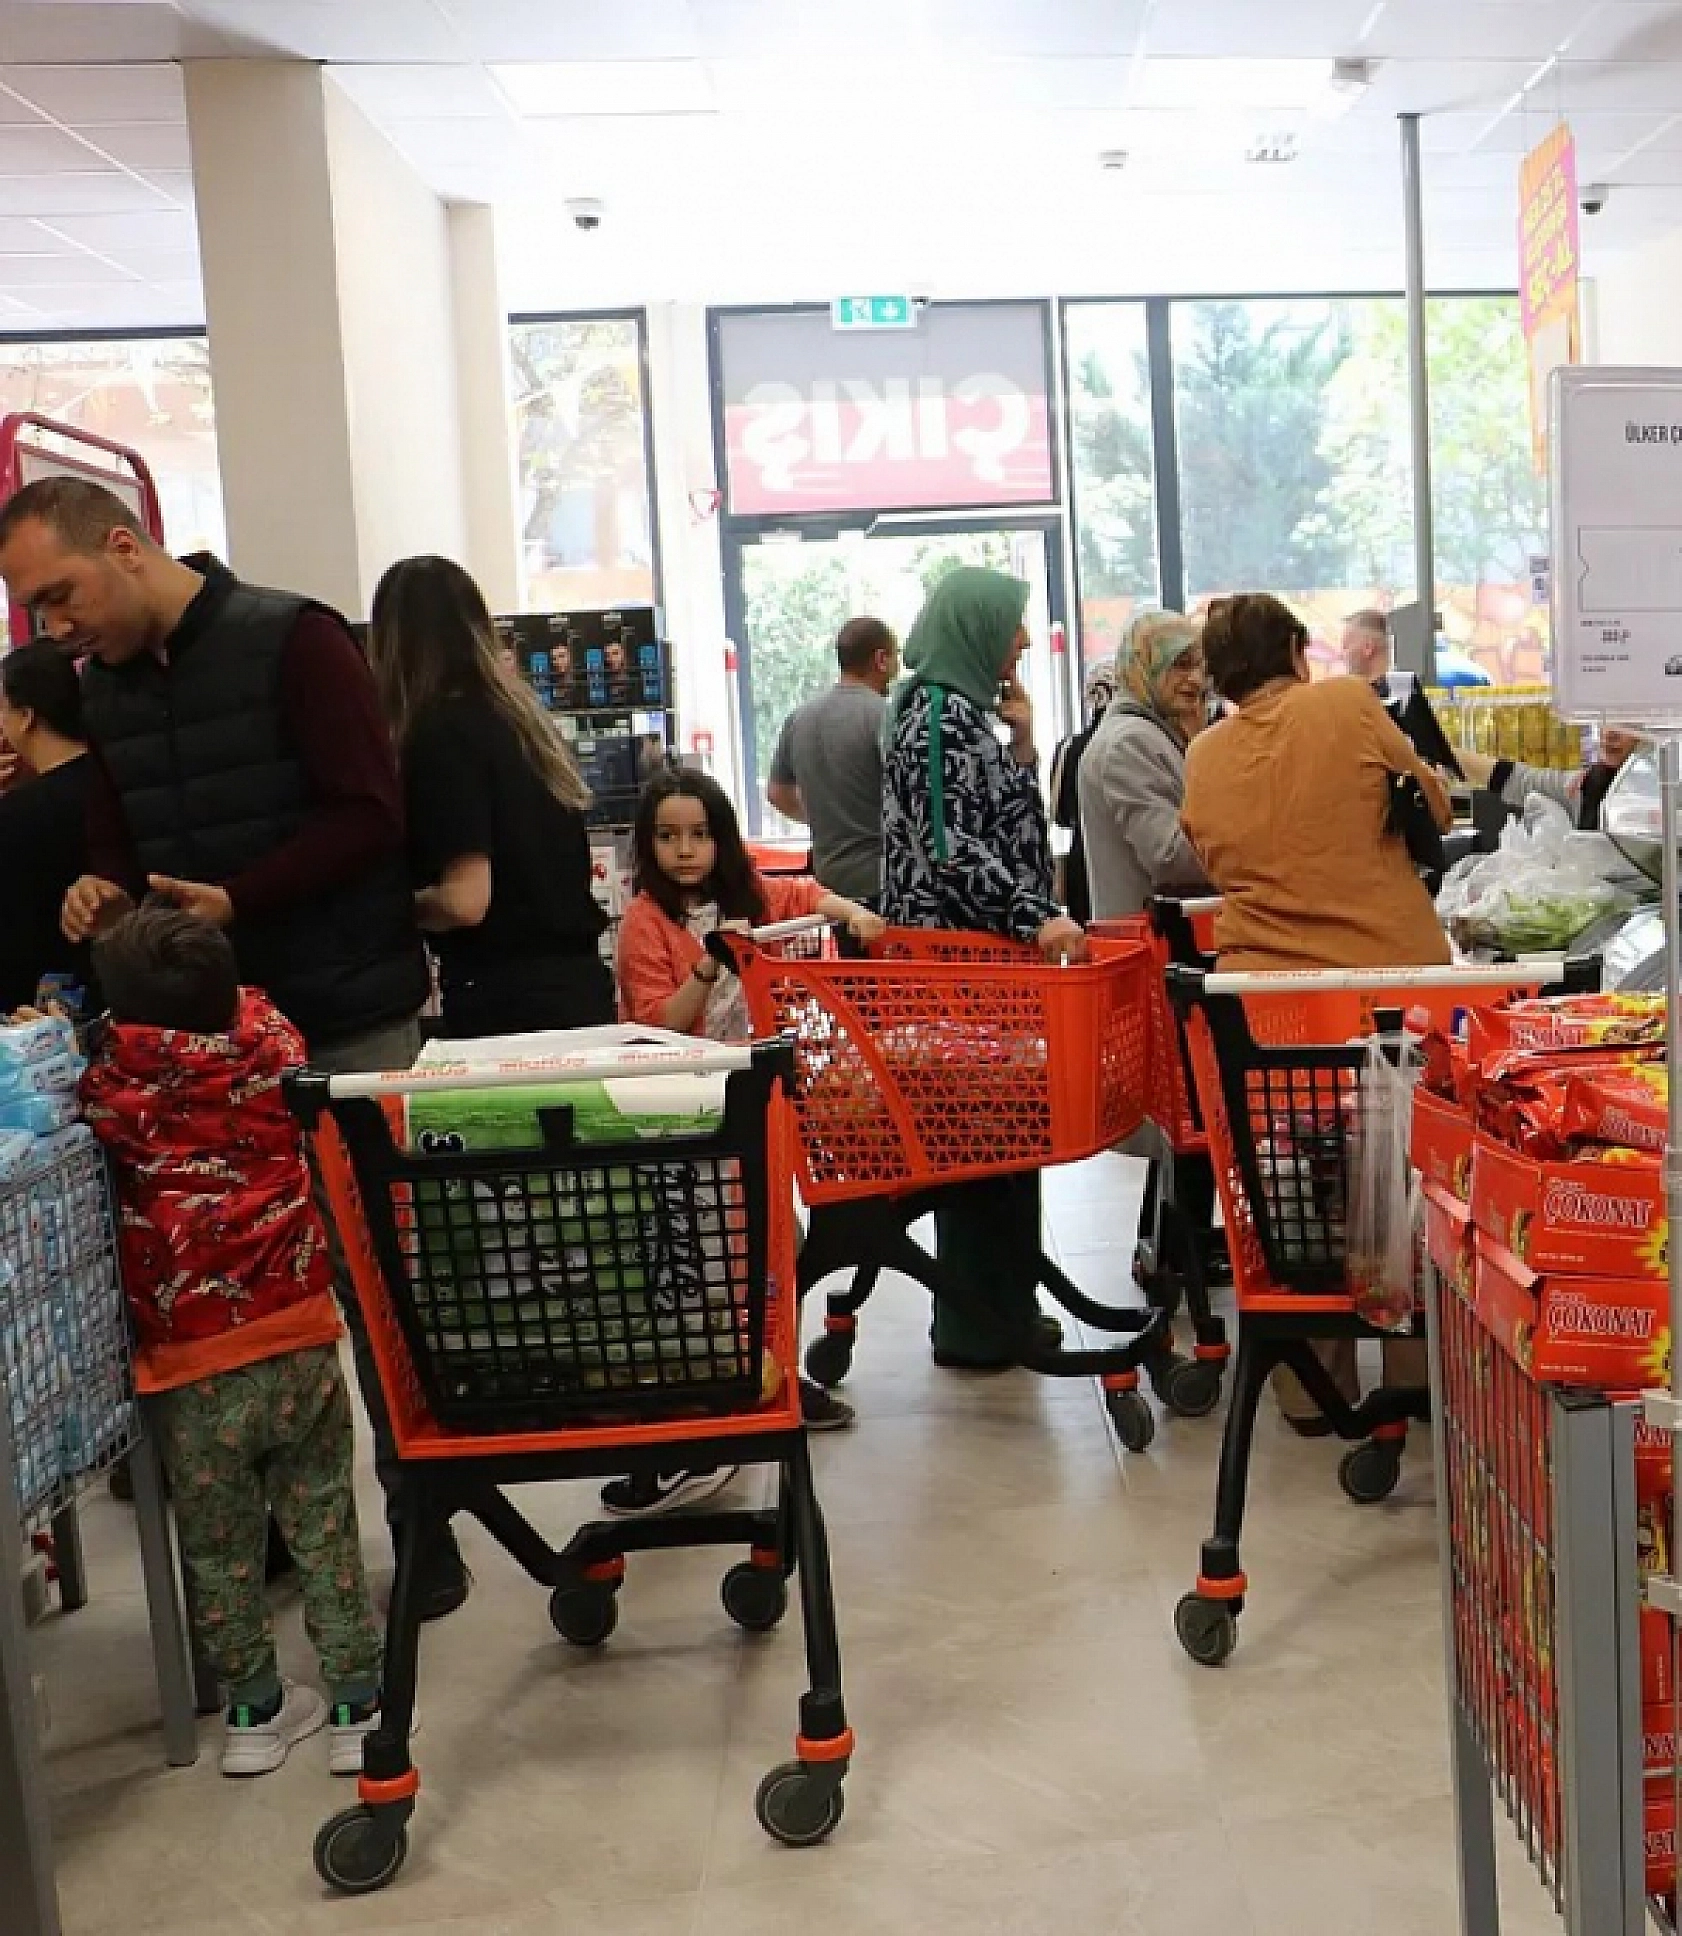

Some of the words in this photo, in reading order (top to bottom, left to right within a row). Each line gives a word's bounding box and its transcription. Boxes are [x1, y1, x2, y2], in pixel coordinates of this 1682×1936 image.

[1626, 420, 1668, 443] ÜLKER
[1671, 423, 1682, 446] Ç
[1544, 1194, 1654, 1228] ÇOKONAT
[1547, 1305, 1656, 1338] ÇOKONAT
